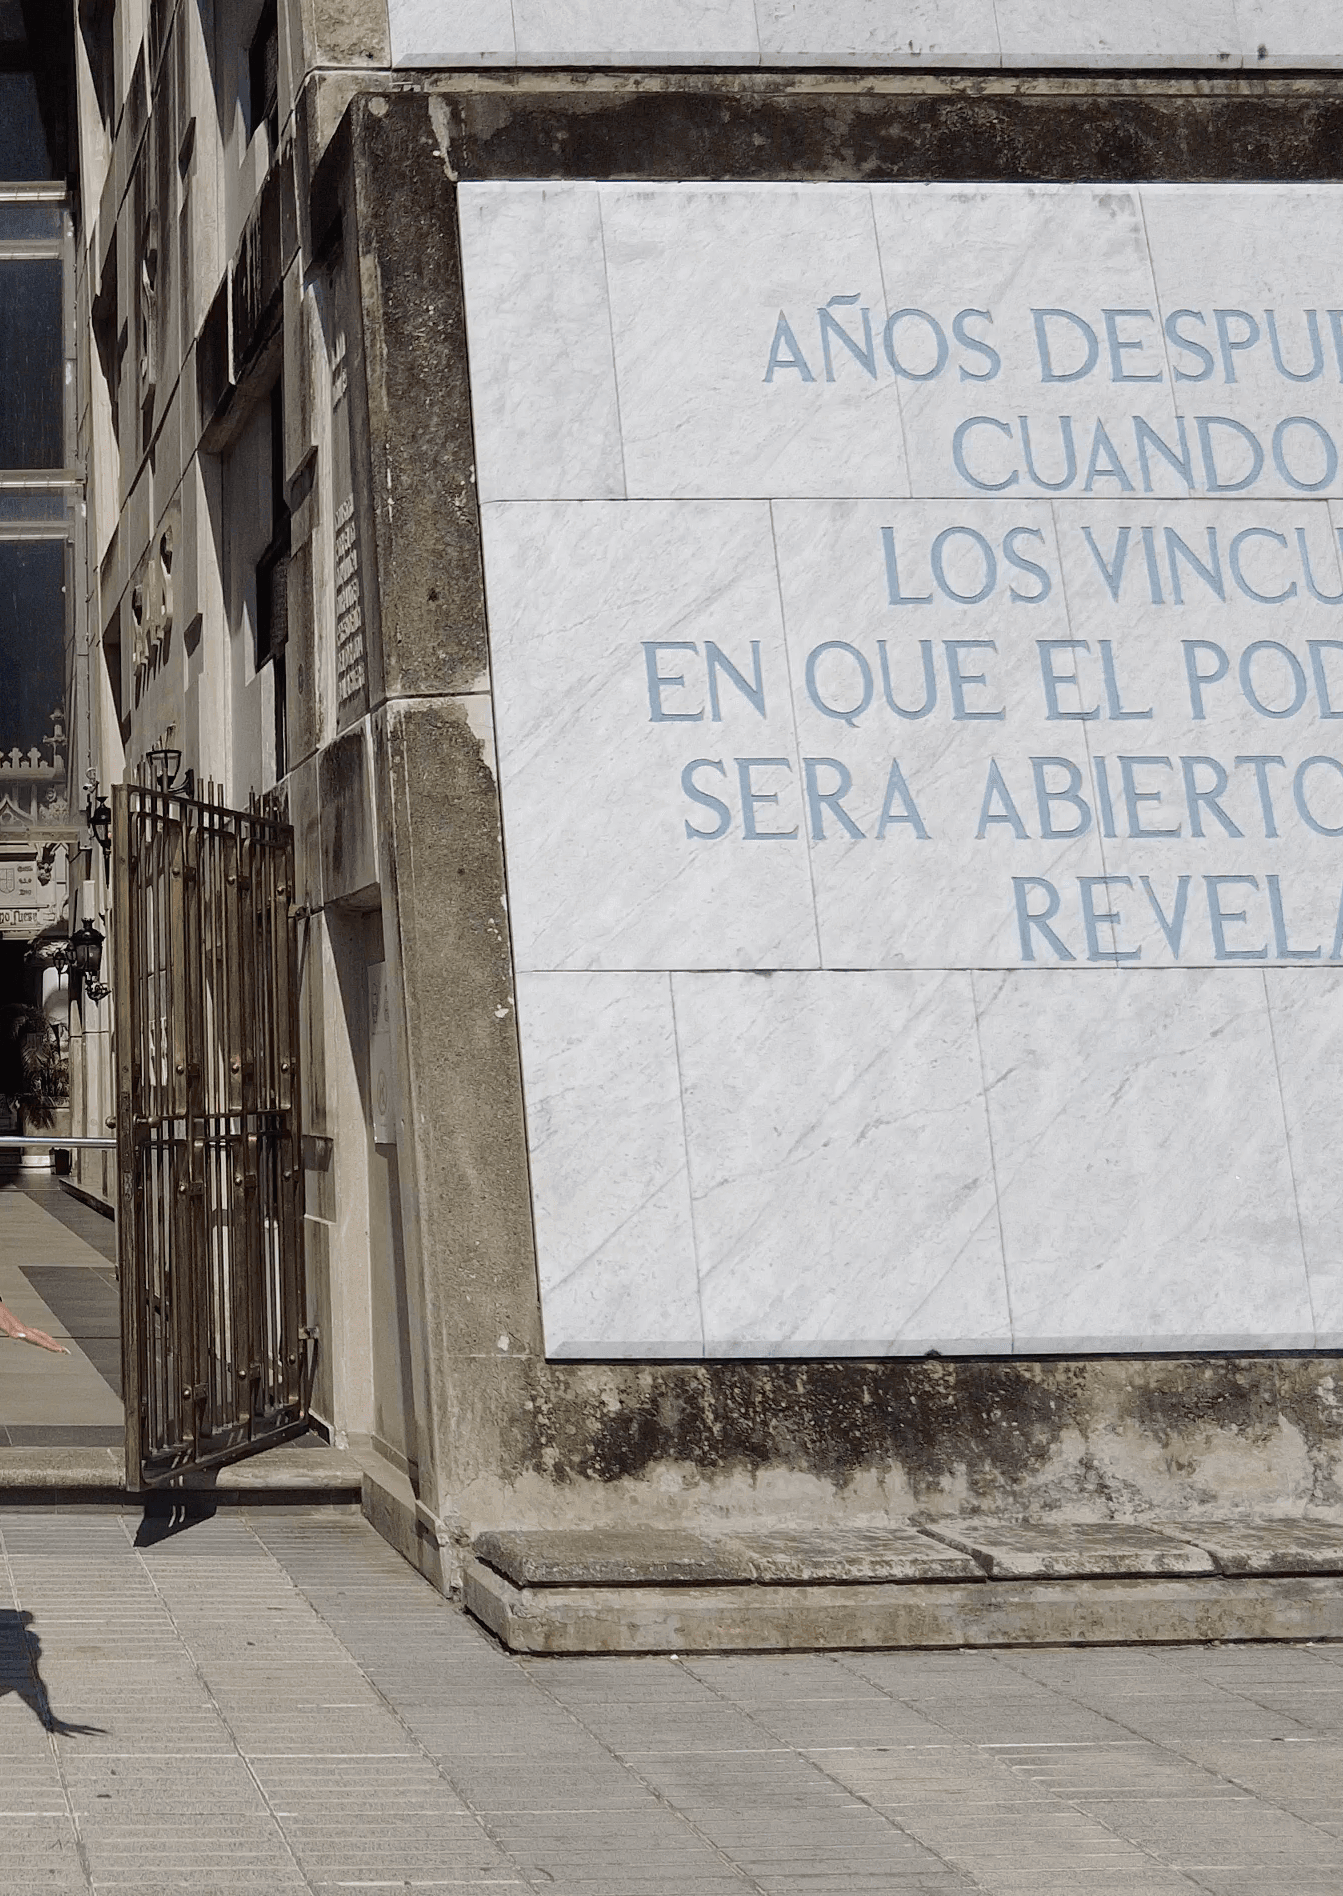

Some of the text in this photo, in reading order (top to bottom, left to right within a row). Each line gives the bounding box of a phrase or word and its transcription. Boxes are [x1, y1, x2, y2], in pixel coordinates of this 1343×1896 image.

[762, 293, 1002, 384] AÑOS
[951, 415, 1340, 494] CUANDO
[880, 526, 1052, 607] LOS
[640, 640, 767, 723] EN
[804, 639, 1007, 729] QUE
[1035, 639, 1154, 722] EL
[680, 755, 1343, 842] SERA ABIERTO
[1011, 874, 1343, 963] REVEL
